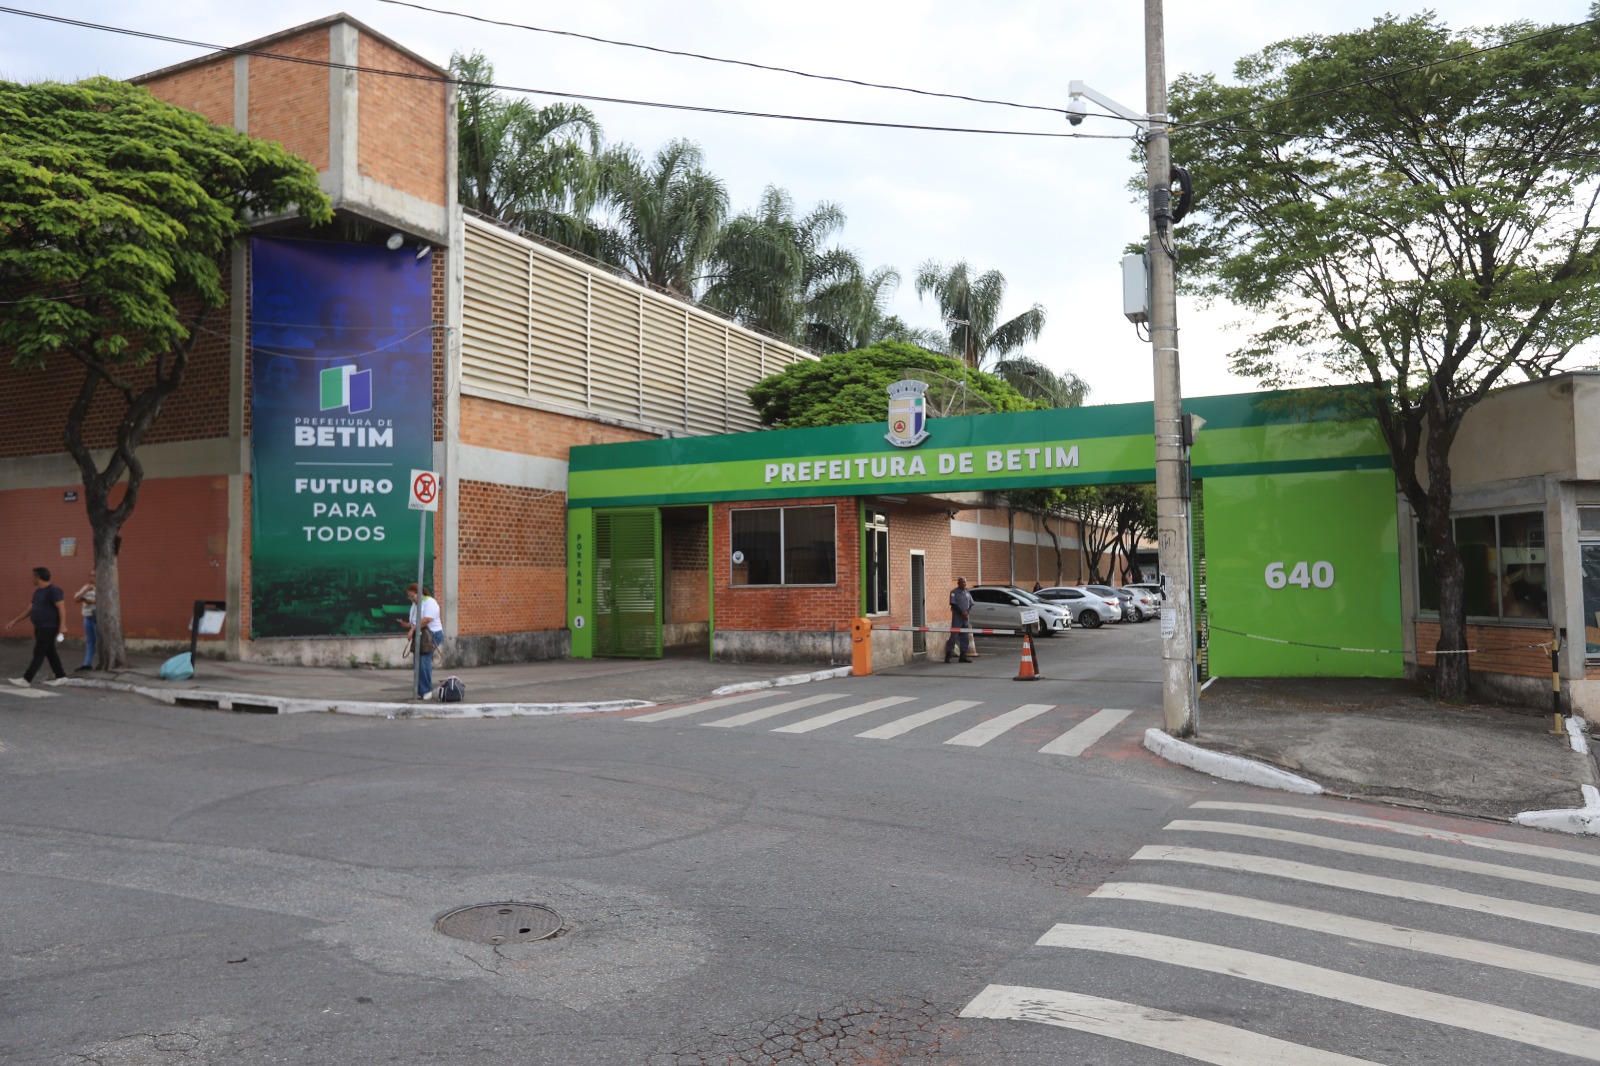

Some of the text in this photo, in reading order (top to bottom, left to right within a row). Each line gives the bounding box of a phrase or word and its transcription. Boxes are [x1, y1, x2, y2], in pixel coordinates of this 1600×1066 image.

[295, 417, 393, 427] PREFEITURA DE
[294, 426, 394, 448] BETIM
[765, 445, 1079, 483] PREFEITURA DE BETIM
[295, 478, 393, 494] FUTURO
[313, 502, 377, 518] PARA
[302, 525, 386, 542] TODOS
[1264, 560, 1335, 589] 640
